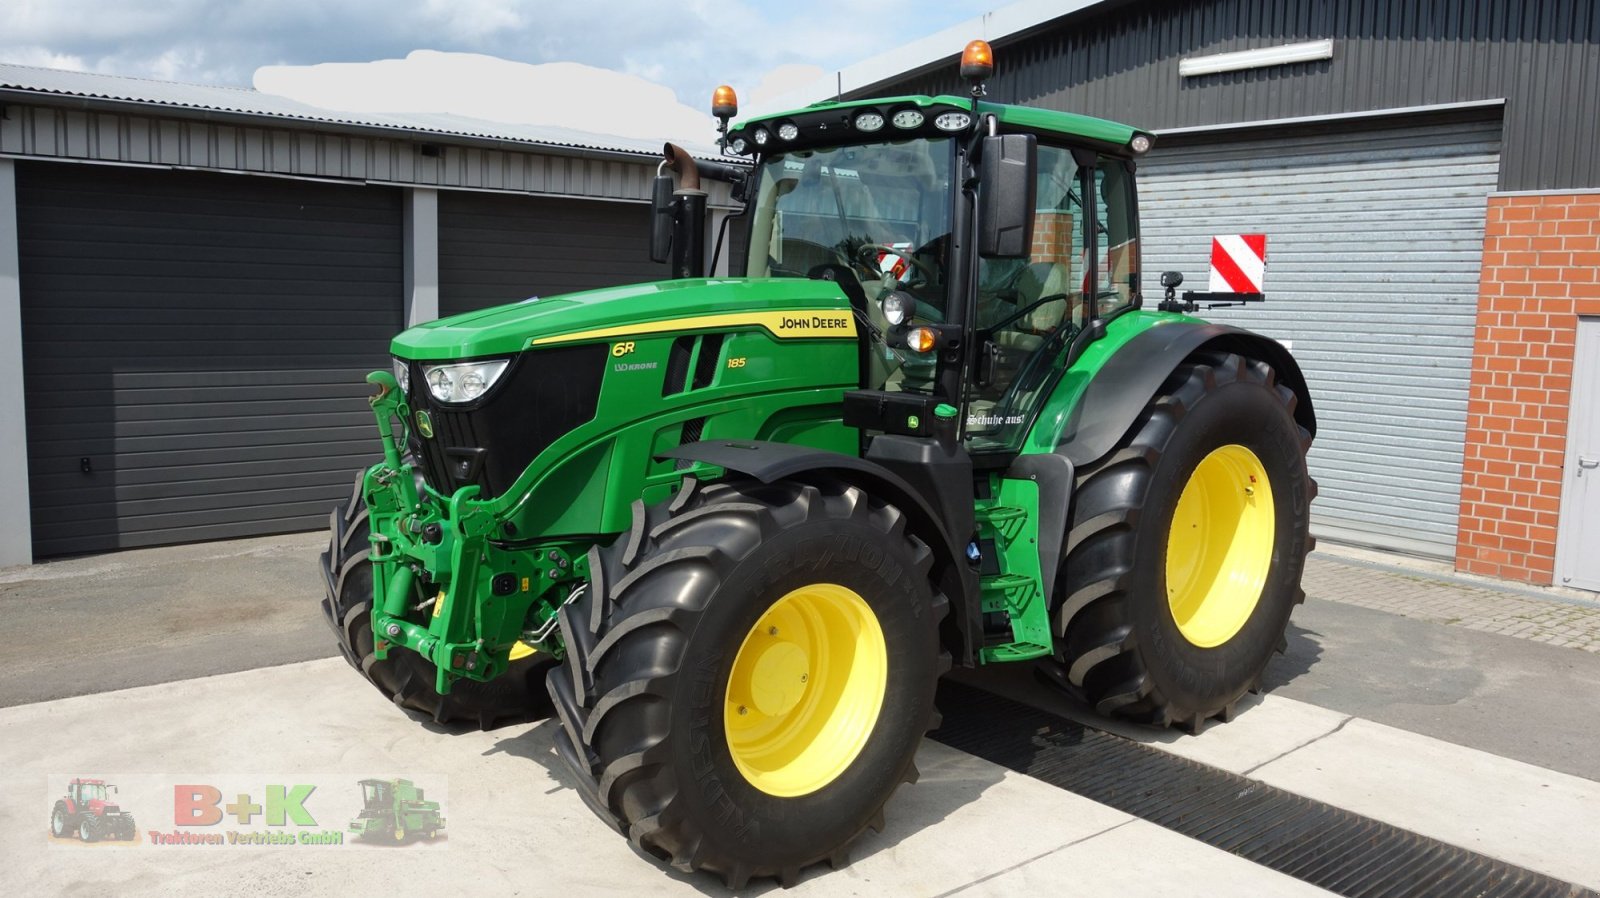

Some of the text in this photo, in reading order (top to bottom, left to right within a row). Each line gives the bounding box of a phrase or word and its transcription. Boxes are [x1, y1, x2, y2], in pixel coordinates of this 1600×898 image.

[779, 317, 848, 329] JOHN DEERE
[612, 341, 635, 357] 6R
[628, 362, 658, 371] KRONE
[727, 357, 747, 369] 185
[966, 414, 1025, 425] Schuhe aus!
